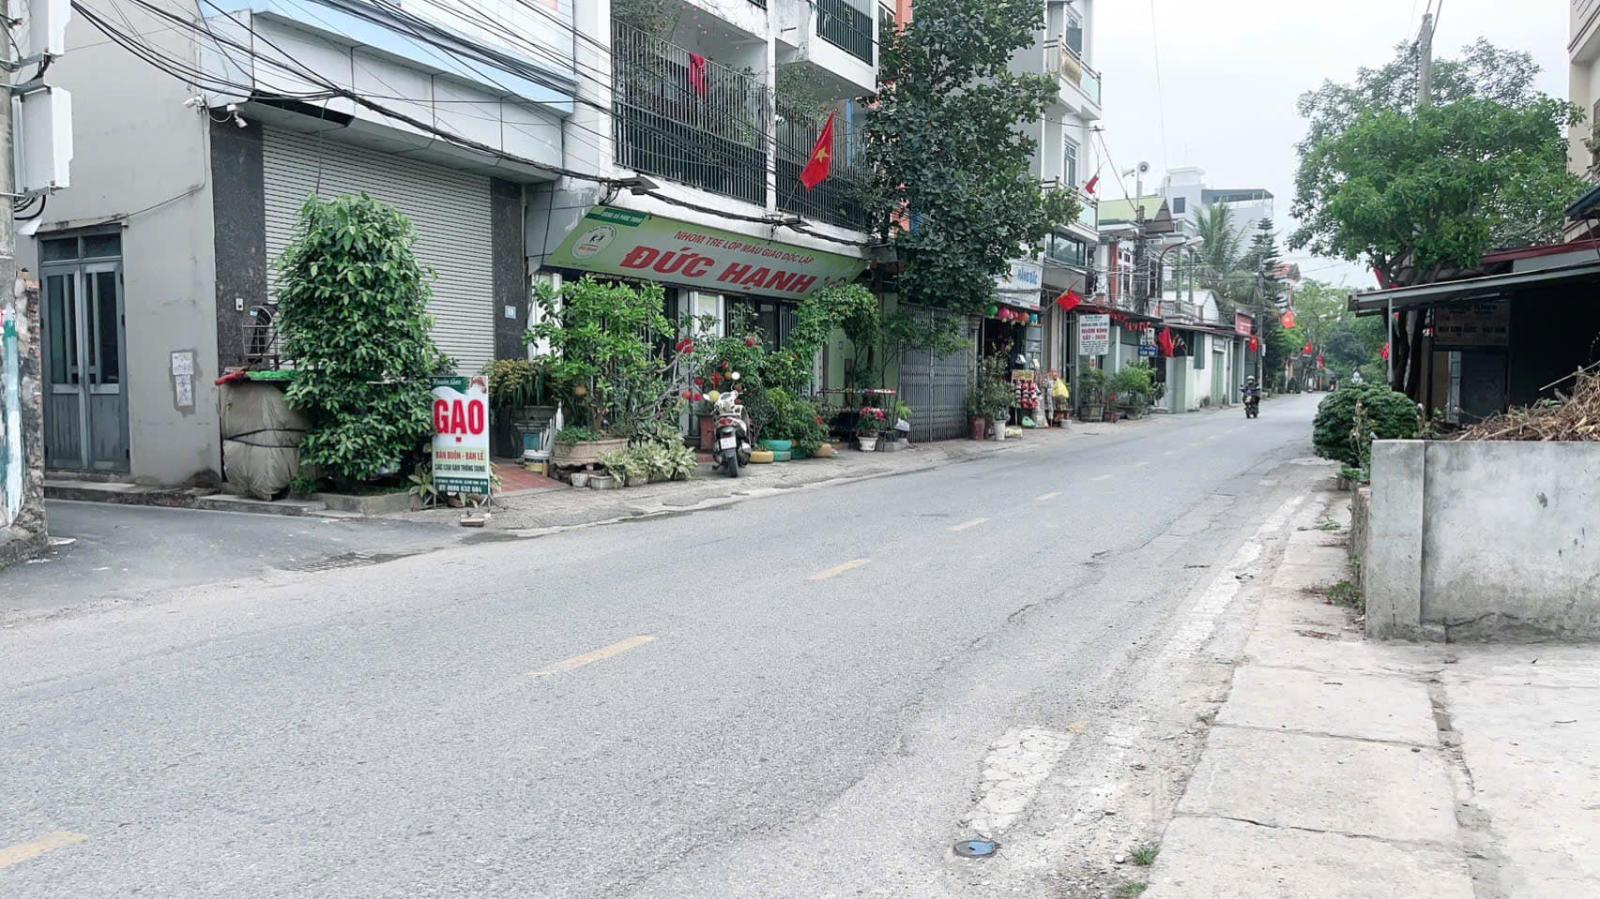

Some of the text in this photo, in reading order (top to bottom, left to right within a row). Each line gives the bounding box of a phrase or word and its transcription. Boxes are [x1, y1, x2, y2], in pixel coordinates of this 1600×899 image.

[619, 246, 817, 294] ĐỨC HẠNH
[722, 239, 742, 251] LỚP
[762, 247, 782, 259] GIÁO
[434, 399, 485, 443] GẠO
